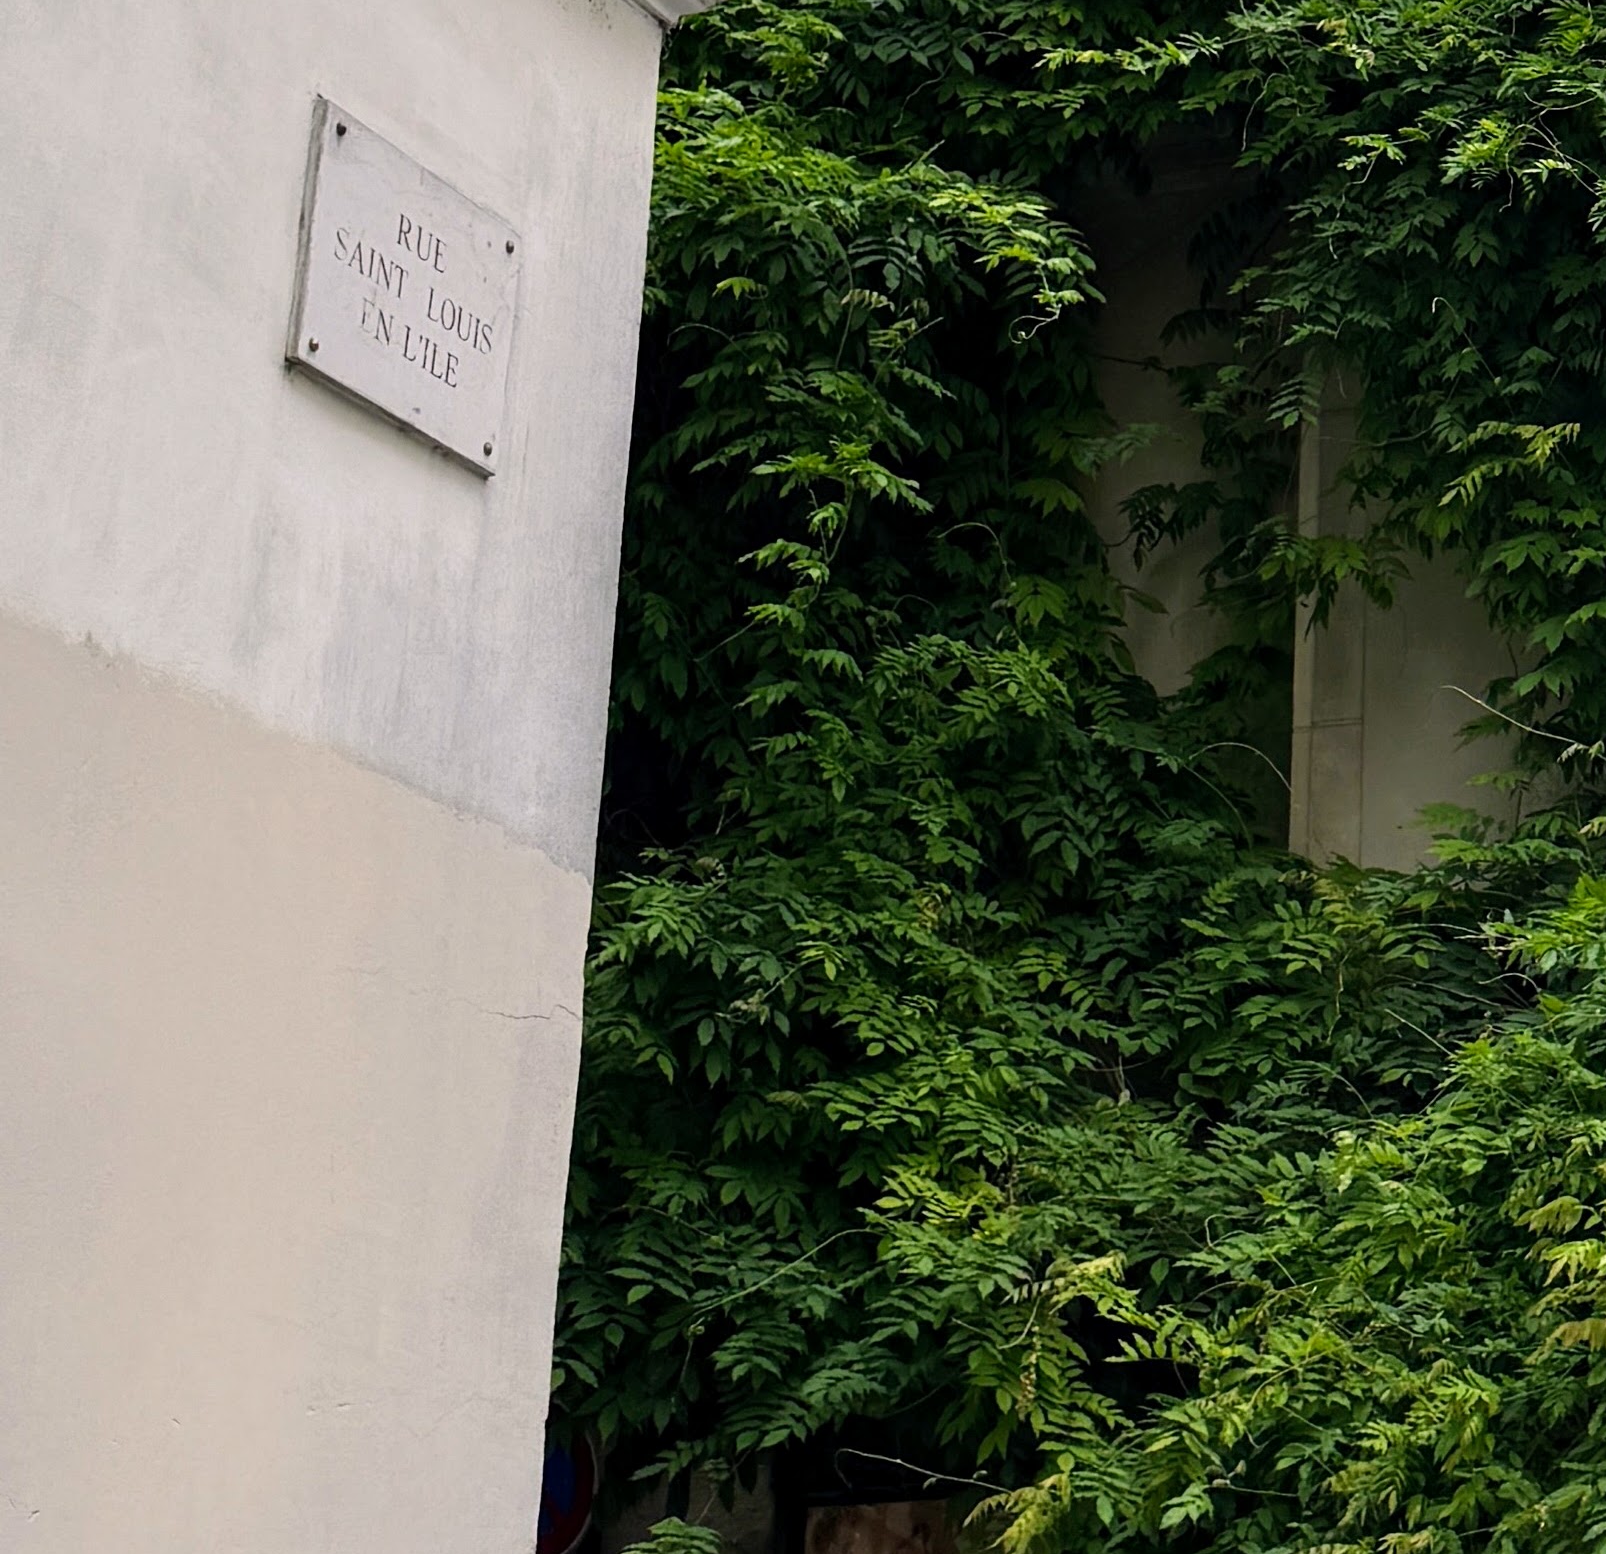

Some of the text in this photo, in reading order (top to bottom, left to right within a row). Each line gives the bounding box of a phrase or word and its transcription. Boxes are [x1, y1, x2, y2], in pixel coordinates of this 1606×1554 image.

[397, 214, 447, 273] RUE
[334, 228, 494, 355] SAINT LOUIS
[361, 297, 393, 346] EN
